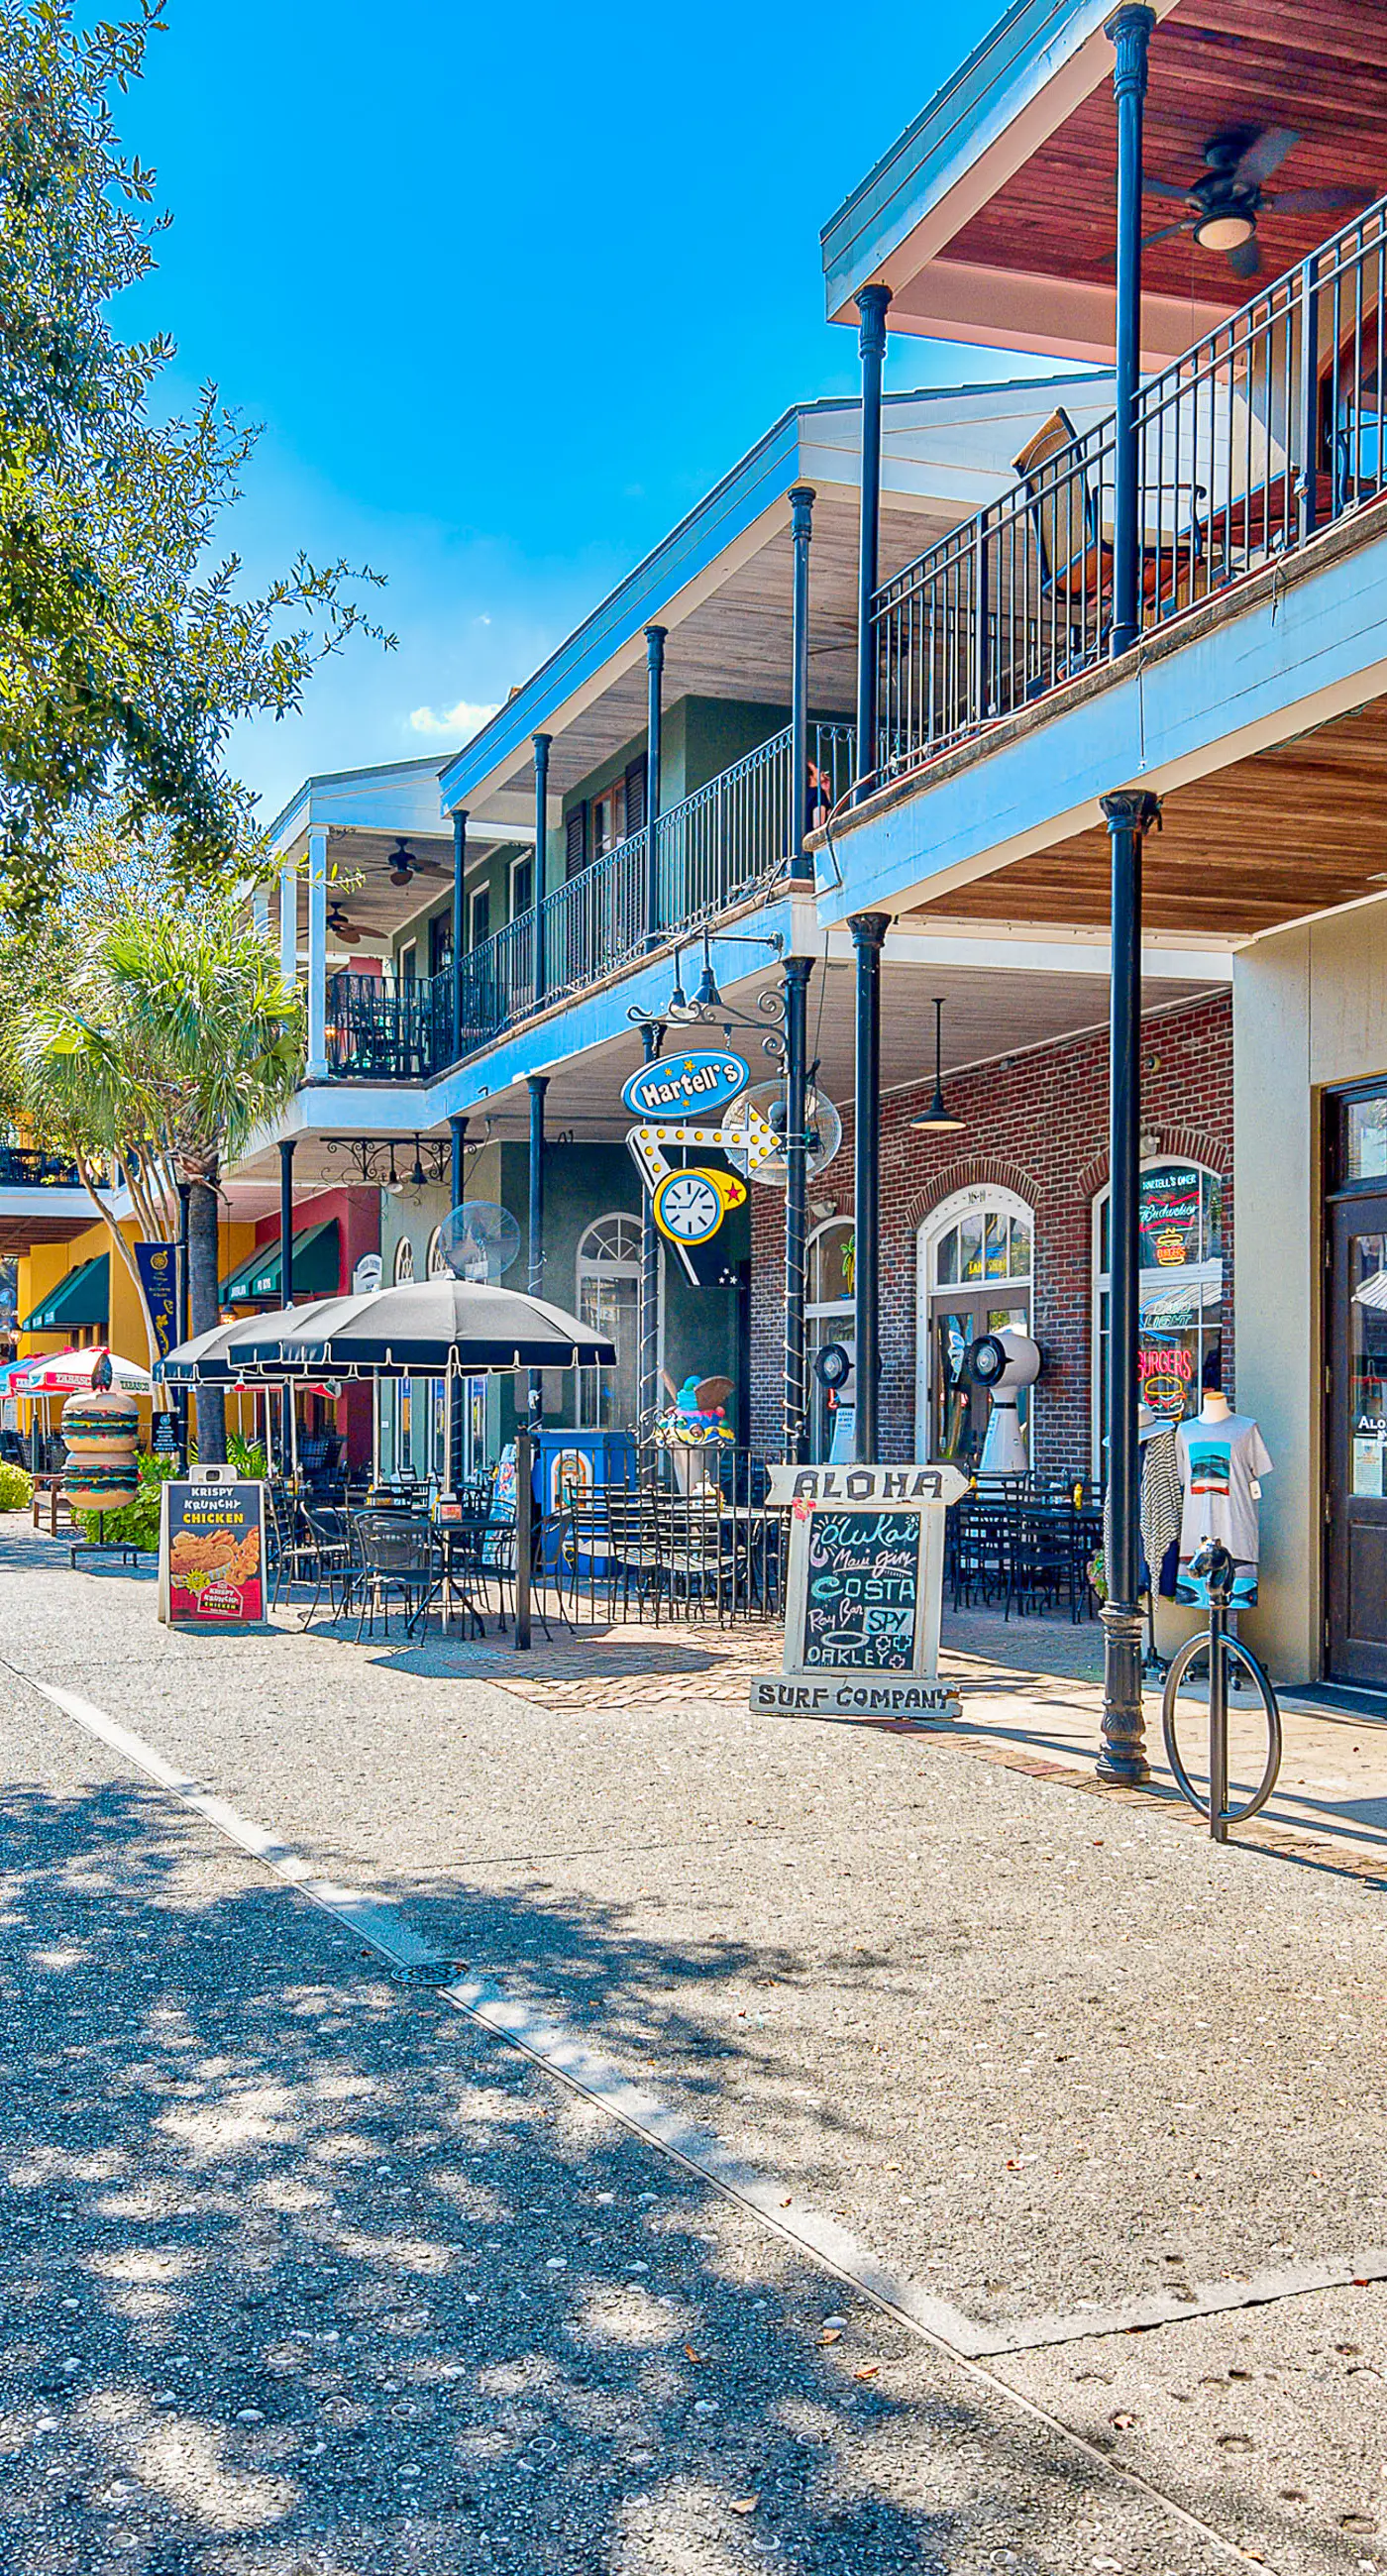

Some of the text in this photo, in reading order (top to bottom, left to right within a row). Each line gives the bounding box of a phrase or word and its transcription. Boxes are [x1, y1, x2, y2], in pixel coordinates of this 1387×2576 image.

[640, 1063, 738, 1108] Hartell's
[1139, 1203, 1199, 1223] Budweiser
[1156, 1247, 1187, 1259] BURGERS
[1143, 1314, 1194, 1329] LIGHT
[1137, 1348, 1192, 1382] BURGERS
[55, 1373, 94, 1387] TABASC
[119, 1379, 150, 1391] TABASCO
[1358, 1415, 1387, 1430] ALO
[191, 1487, 234, 1497] KRISPY
[792, 1469, 942, 1501] ALOHA
[184, 1499, 242, 1511] KRUNCHY
[182, 1513, 244, 1524] CHICKEN
[832, 1548, 917, 1579] Maui Jim
[810, 1575, 915, 1602] COSTA
[807, 1597, 864, 1634] Ray Ban
[867, 1609, 908, 1634] SPY
[806, 1646, 893, 1666] OAKLEY
[758, 1683, 951, 1710] SURF COMPANY
